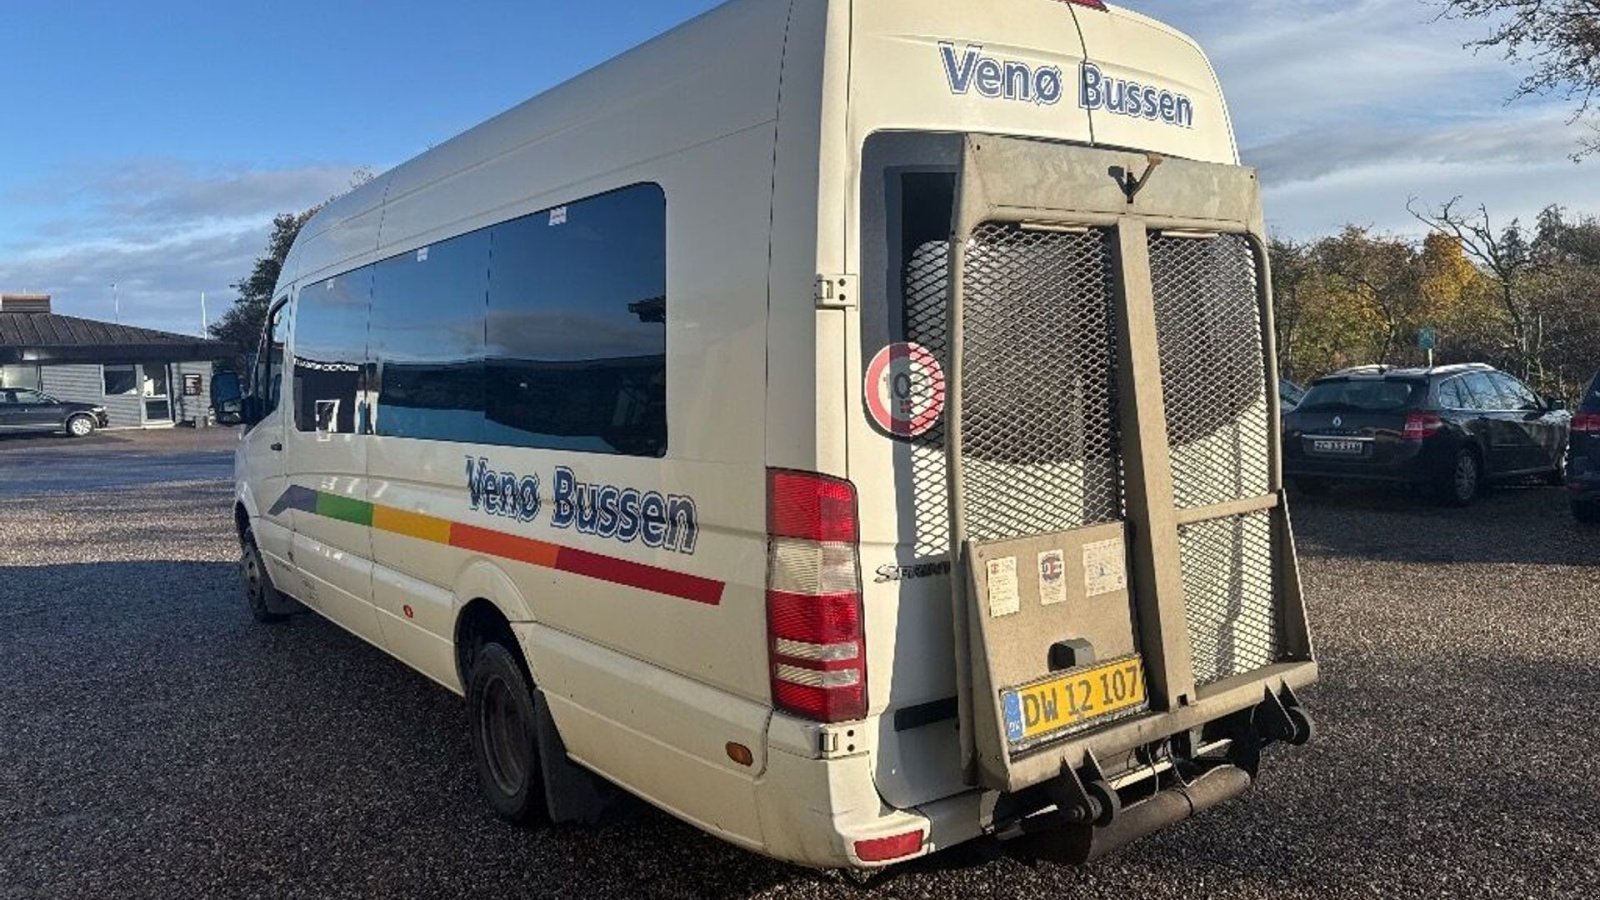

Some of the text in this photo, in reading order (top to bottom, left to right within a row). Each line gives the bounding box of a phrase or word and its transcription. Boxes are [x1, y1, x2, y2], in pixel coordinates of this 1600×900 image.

[938, 41, 1194, 129] Venø Bussen
[465, 455, 698, 554] Venø Bussen
[1022, 688, 1059, 728] DW
[1065, 679, 1093, 716] 12
[1100, 666, 1138, 706] 107
